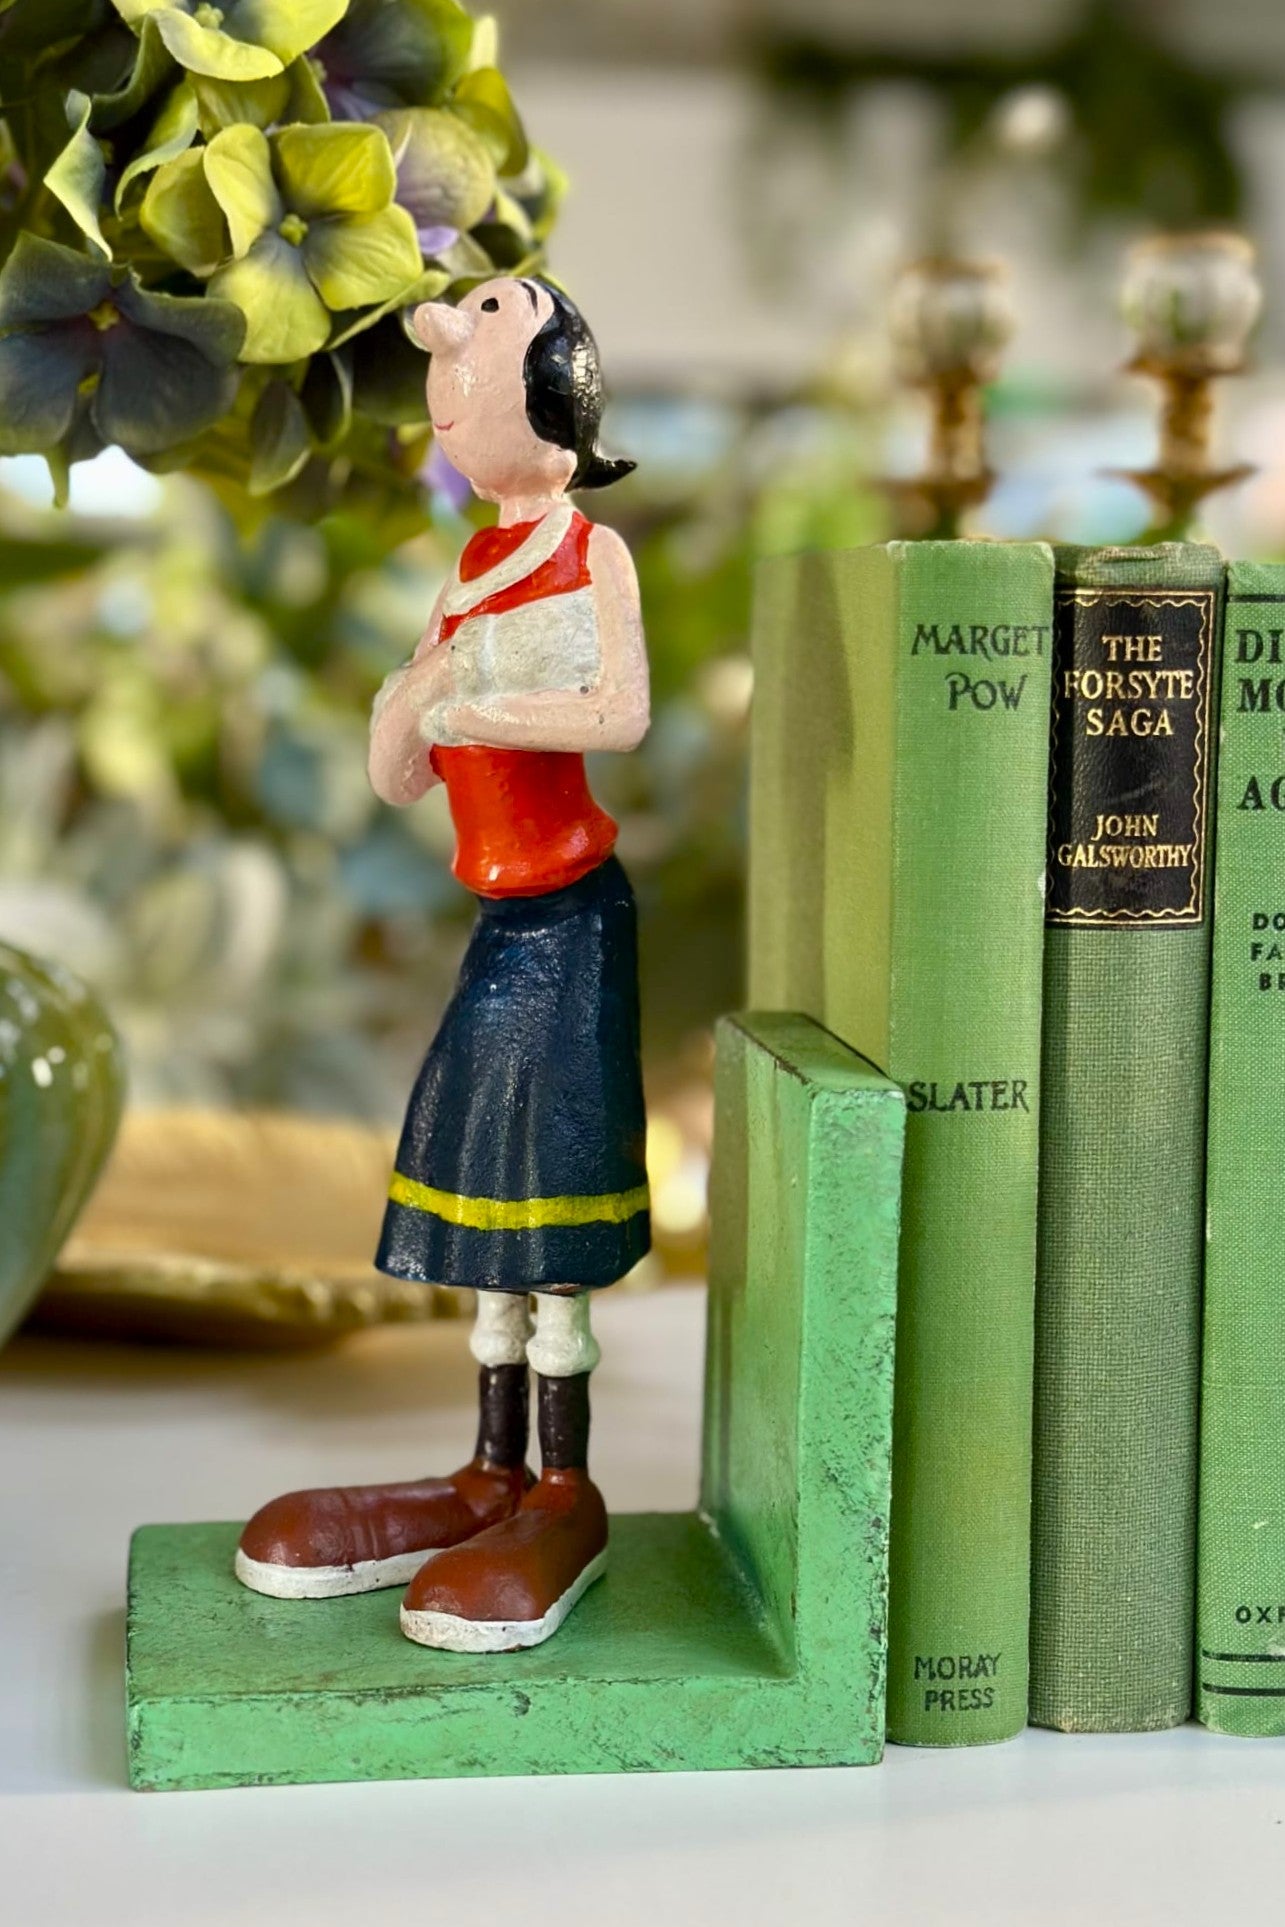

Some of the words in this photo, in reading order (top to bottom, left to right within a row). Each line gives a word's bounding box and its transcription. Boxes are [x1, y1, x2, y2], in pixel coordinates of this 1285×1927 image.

[911, 624, 1050, 662] MARGET
[1102, 635, 1162, 662] THE
[945, 672, 1028, 711] POW
[1064, 669, 1194, 700] FORSYTE
[1086, 708, 1174, 736] SAGA
[1091, 814, 1159, 841] JOHN
[1058, 843, 1192, 868] GALSWORTHY
[907, 1080, 1030, 1113] SLATER
[914, 1652, 1002, 1680] MORAY
[925, 1687, 995, 1712] PRESS
